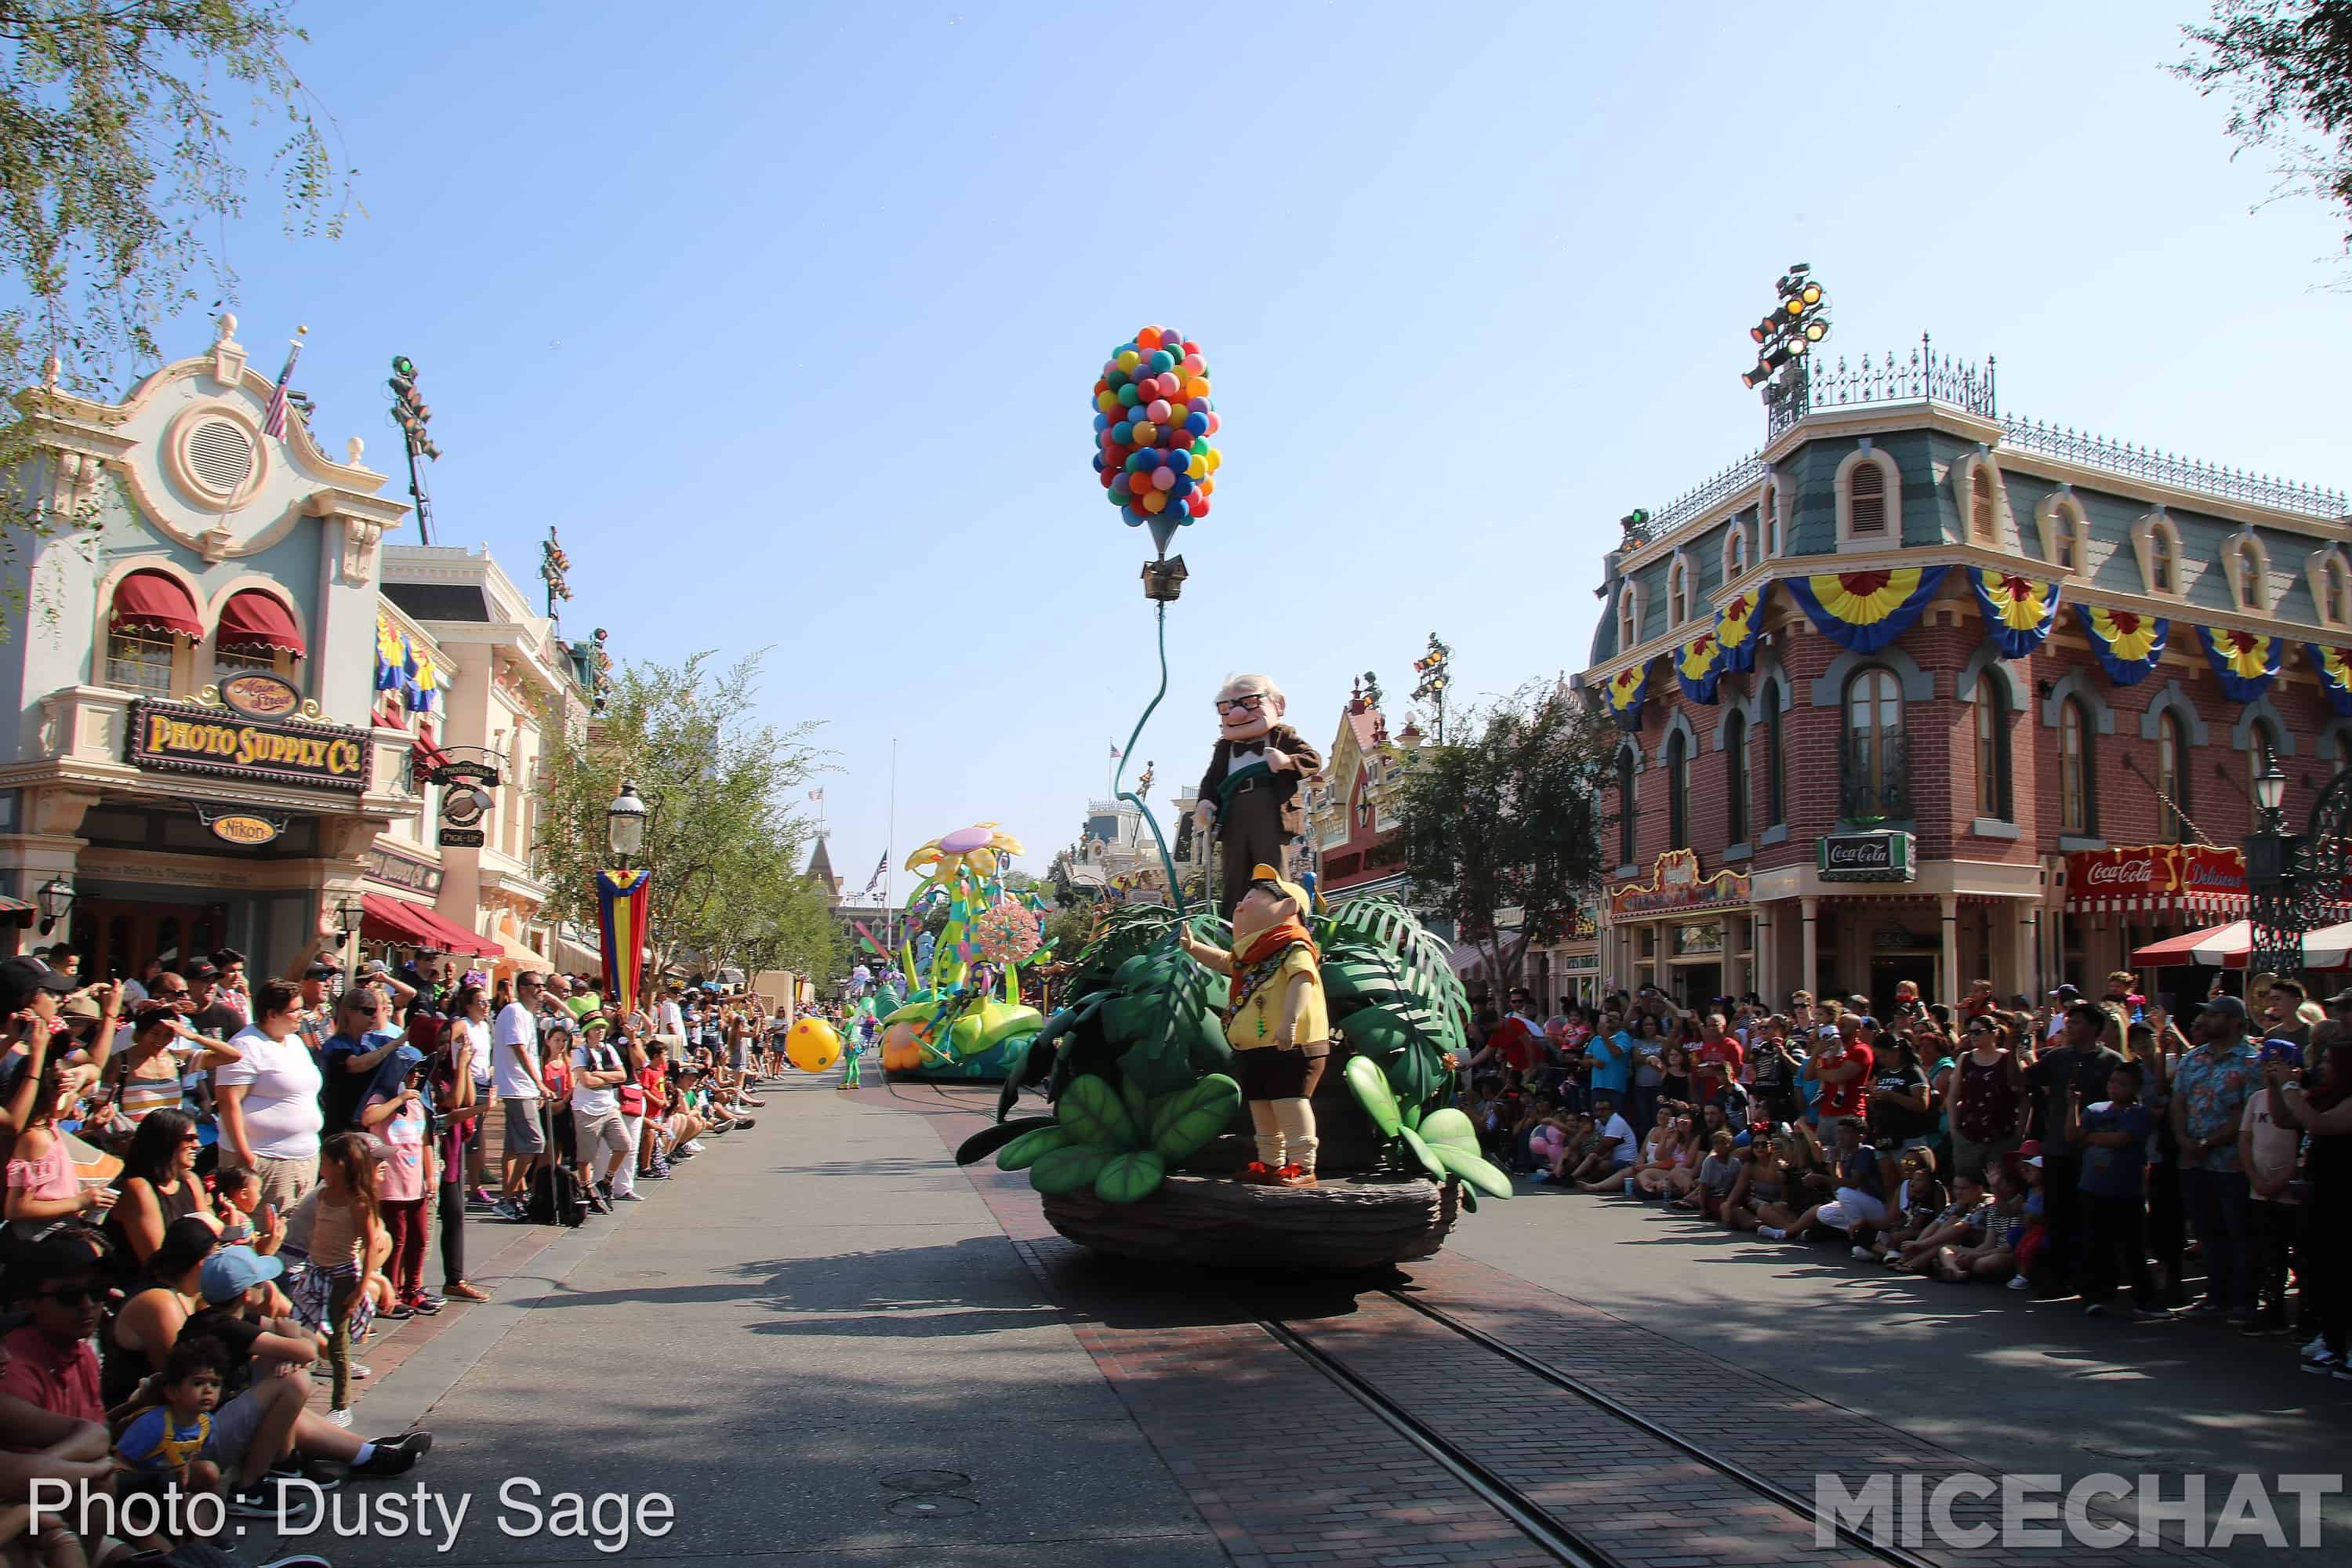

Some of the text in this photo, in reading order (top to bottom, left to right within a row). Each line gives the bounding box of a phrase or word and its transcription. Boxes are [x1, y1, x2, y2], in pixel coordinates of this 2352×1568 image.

[235, 679, 278, 696] Main
[251, 693, 290, 711] Street
[146, 714, 236, 757] PHOTO
[236, 728, 330, 767] SUPPLY
[224, 818, 264, 839] Nikon
[444, 833, 479, 843] PICK-UP
